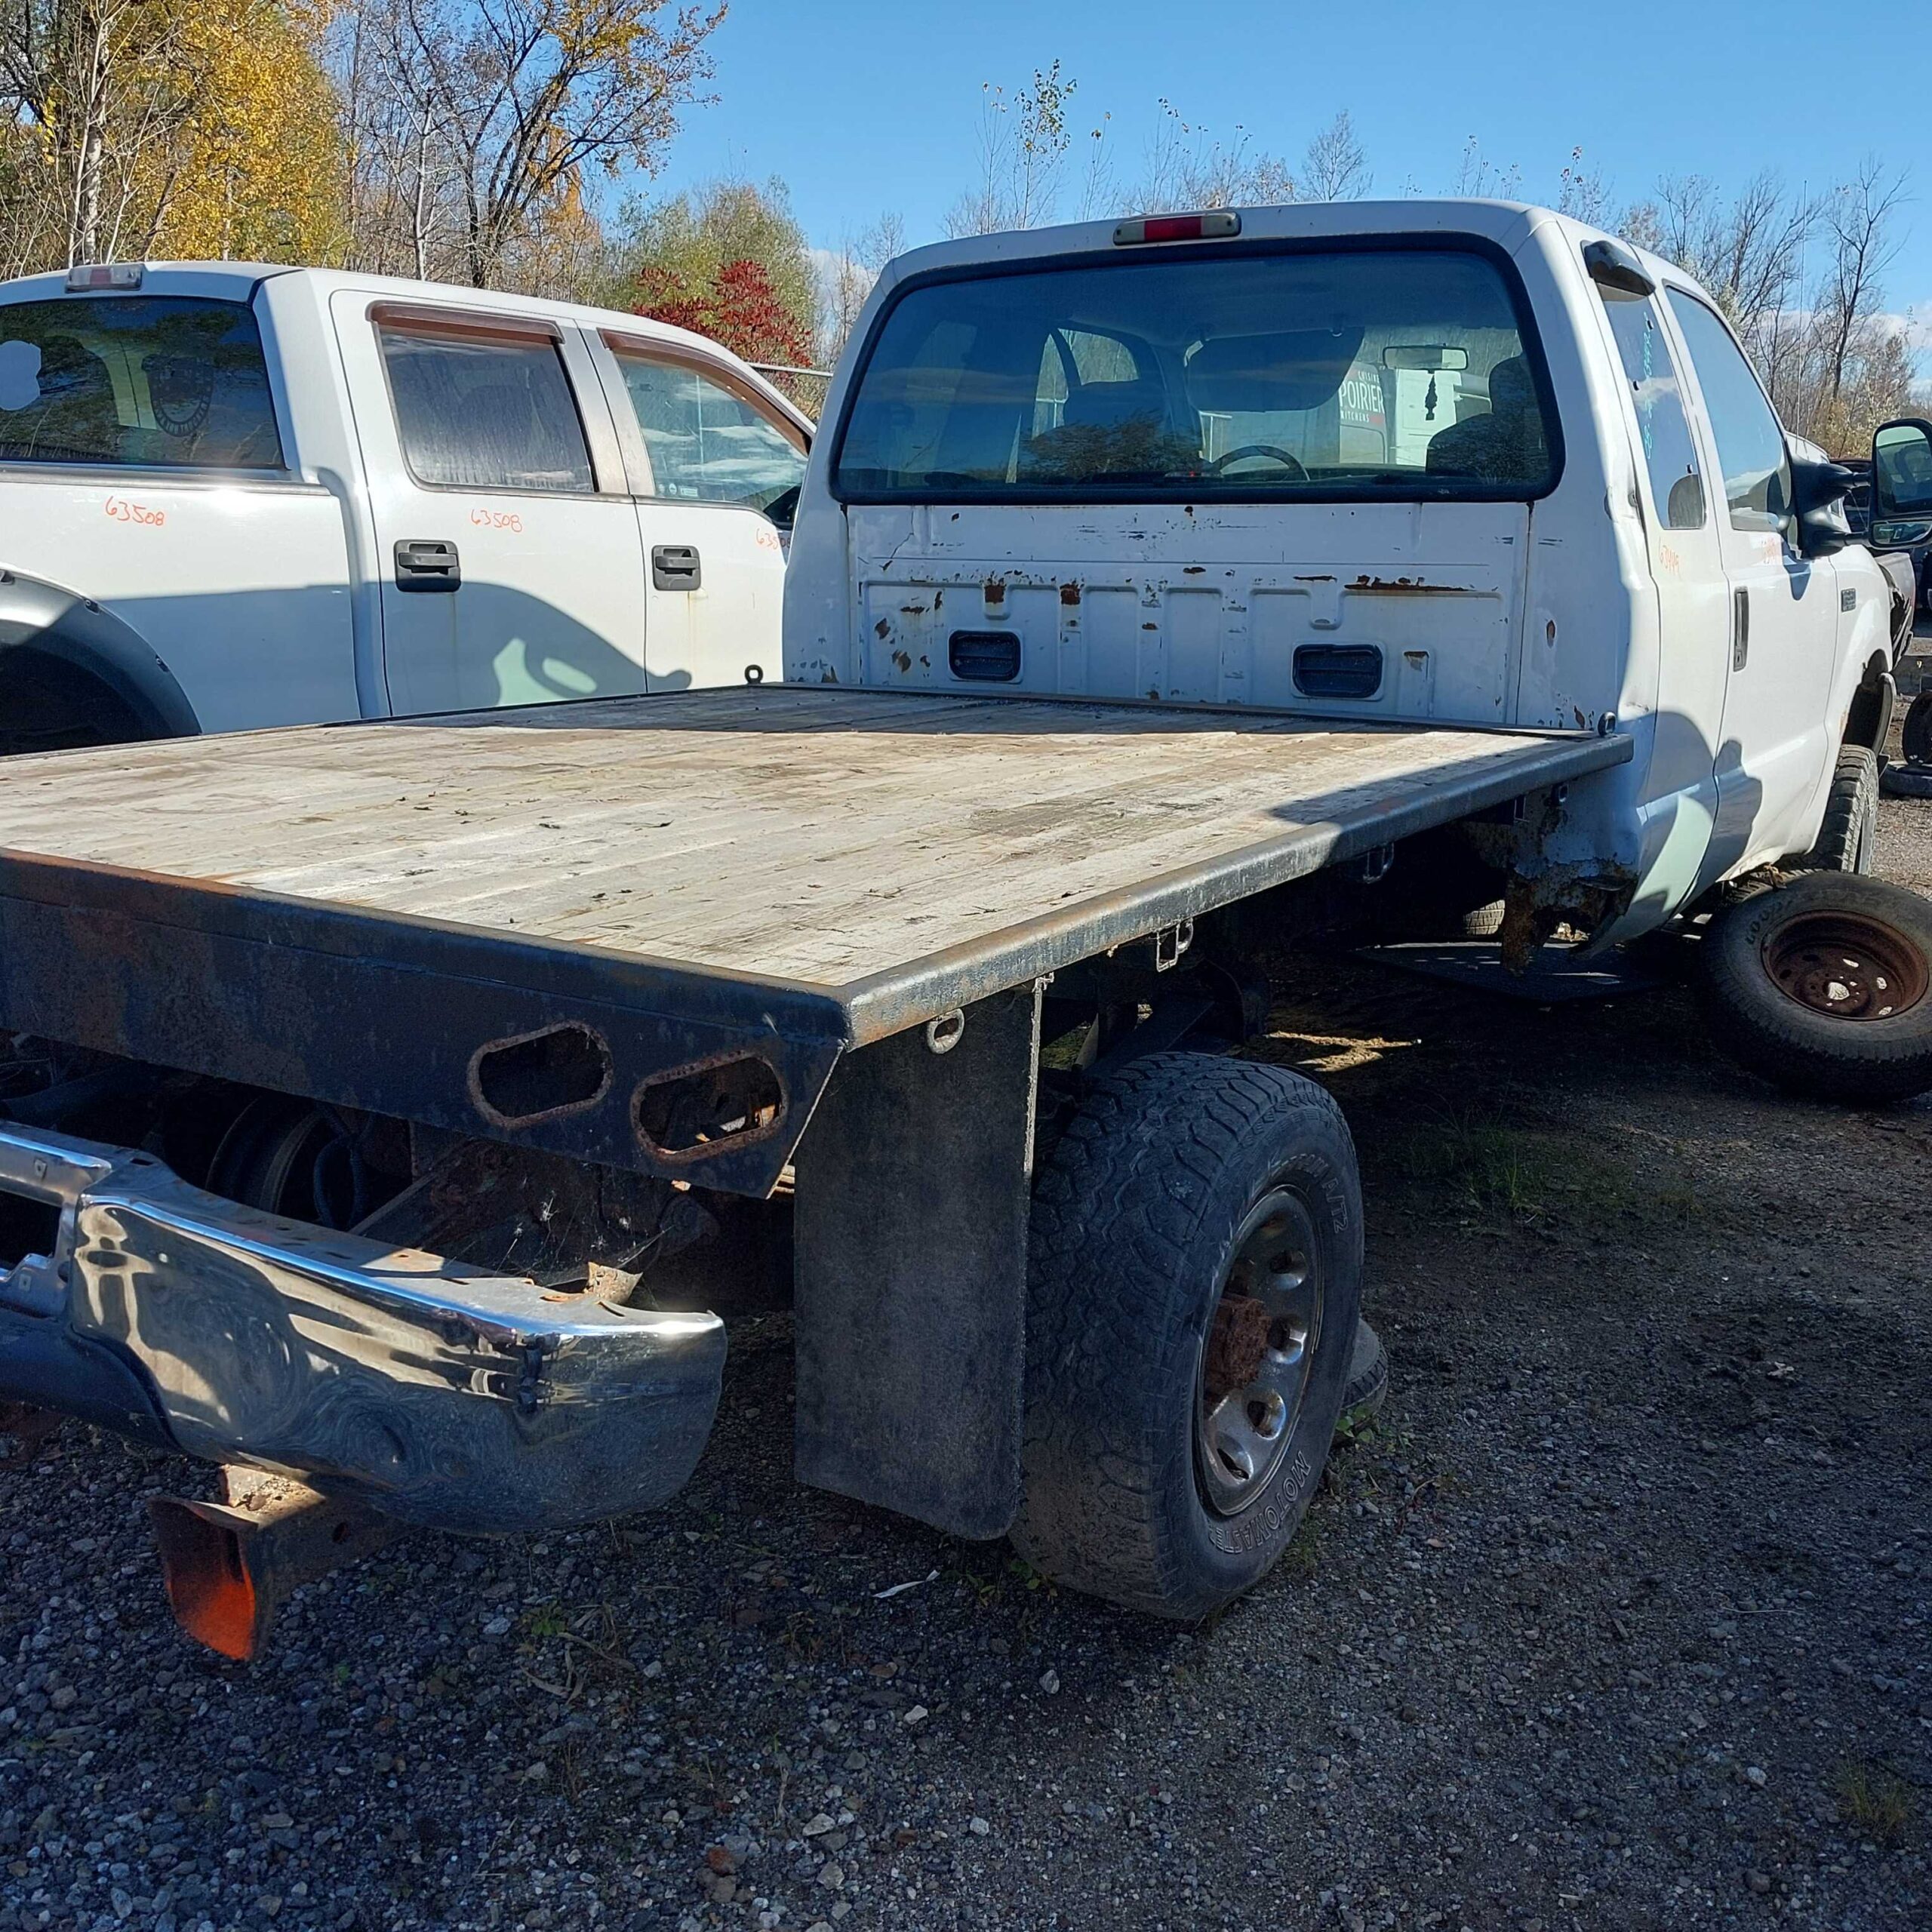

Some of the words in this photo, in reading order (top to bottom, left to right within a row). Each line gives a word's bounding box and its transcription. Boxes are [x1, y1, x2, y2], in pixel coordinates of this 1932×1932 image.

[1338, 380, 1385, 414] POIRIER
[105, 495, 165, 526] 63508
[471, 509, 523, 533] 63508
[1208, 1450, 1312, 1553] MOTOMASTE
